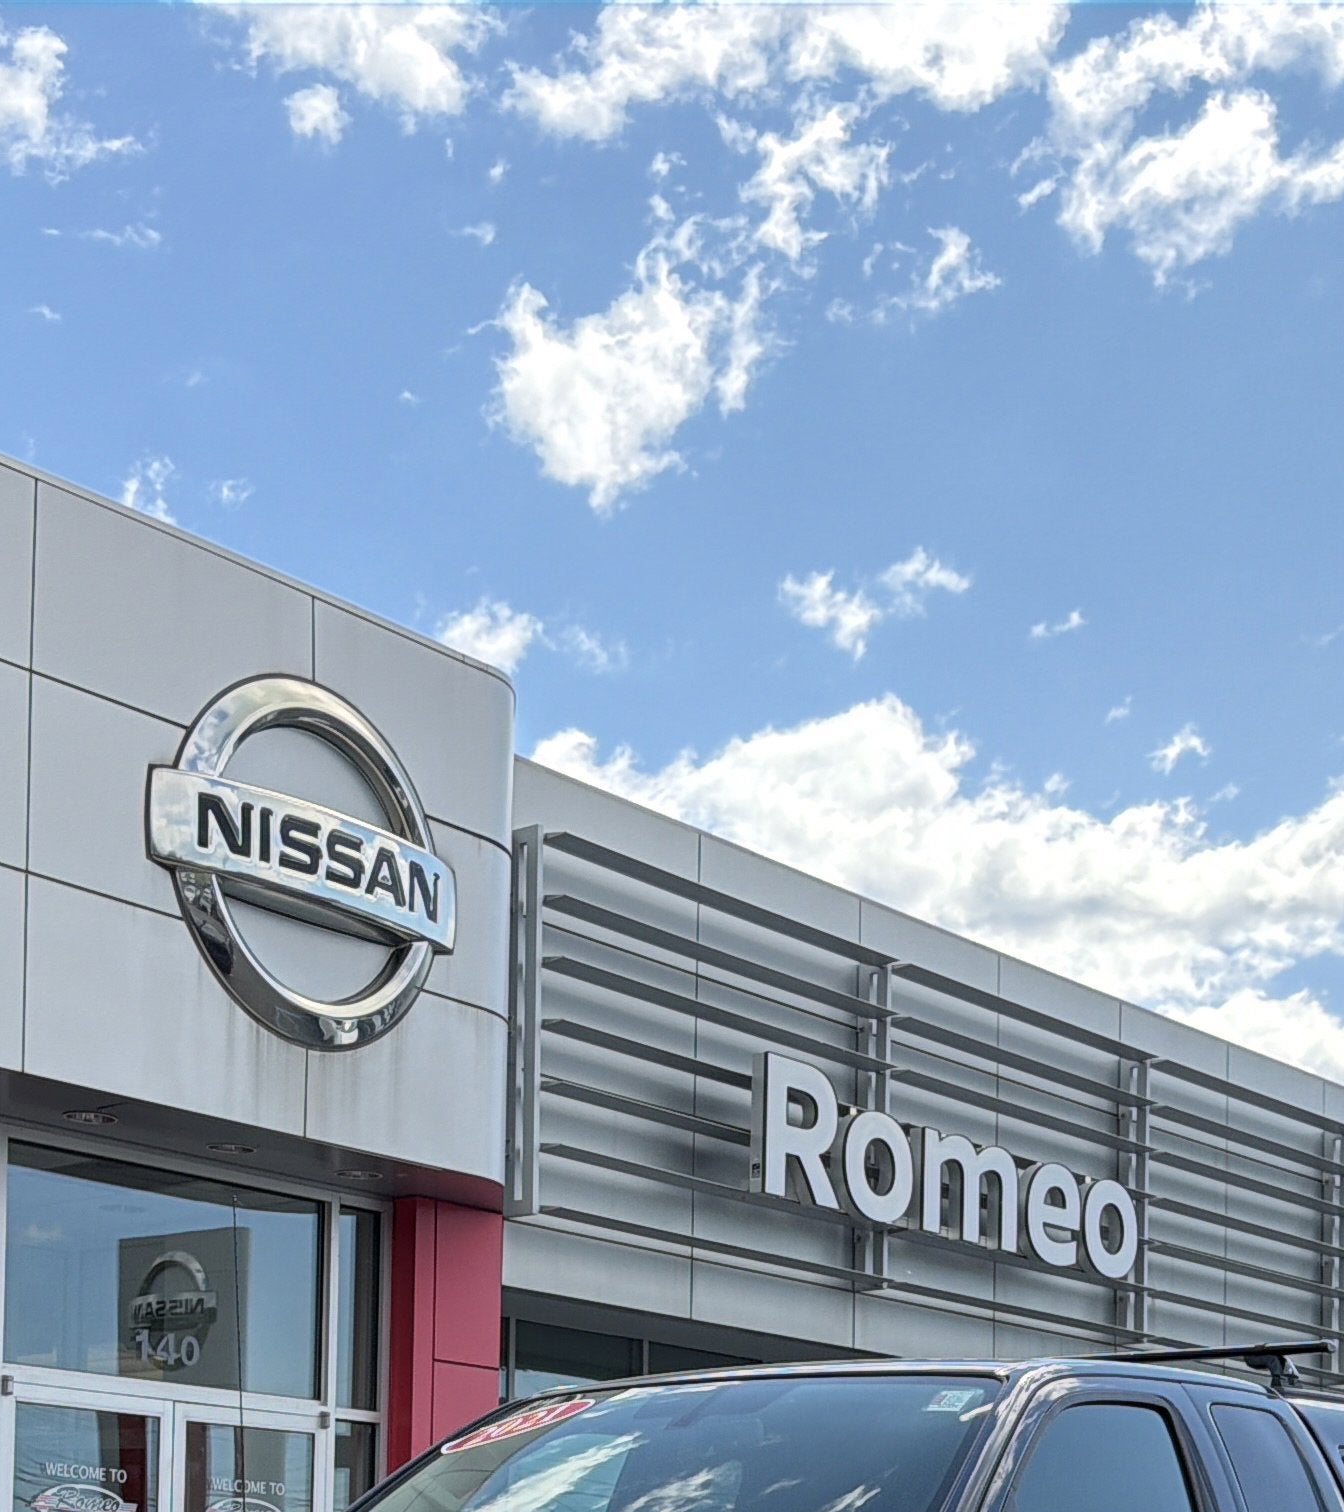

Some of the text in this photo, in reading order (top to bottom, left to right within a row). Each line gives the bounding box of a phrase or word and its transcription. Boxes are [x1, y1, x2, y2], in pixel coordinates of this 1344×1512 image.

[197, 792, 441, 923] NISSAN
[760, 1051, 1138, 1279] Romeo
[135, 1329, 200, 1366] 140
[46, 1462, 128, 1483] WELCOME TO
[211, 1478, 285, 1496] WELCOME TO
[56, 1487, 120, 1512] Romeo
